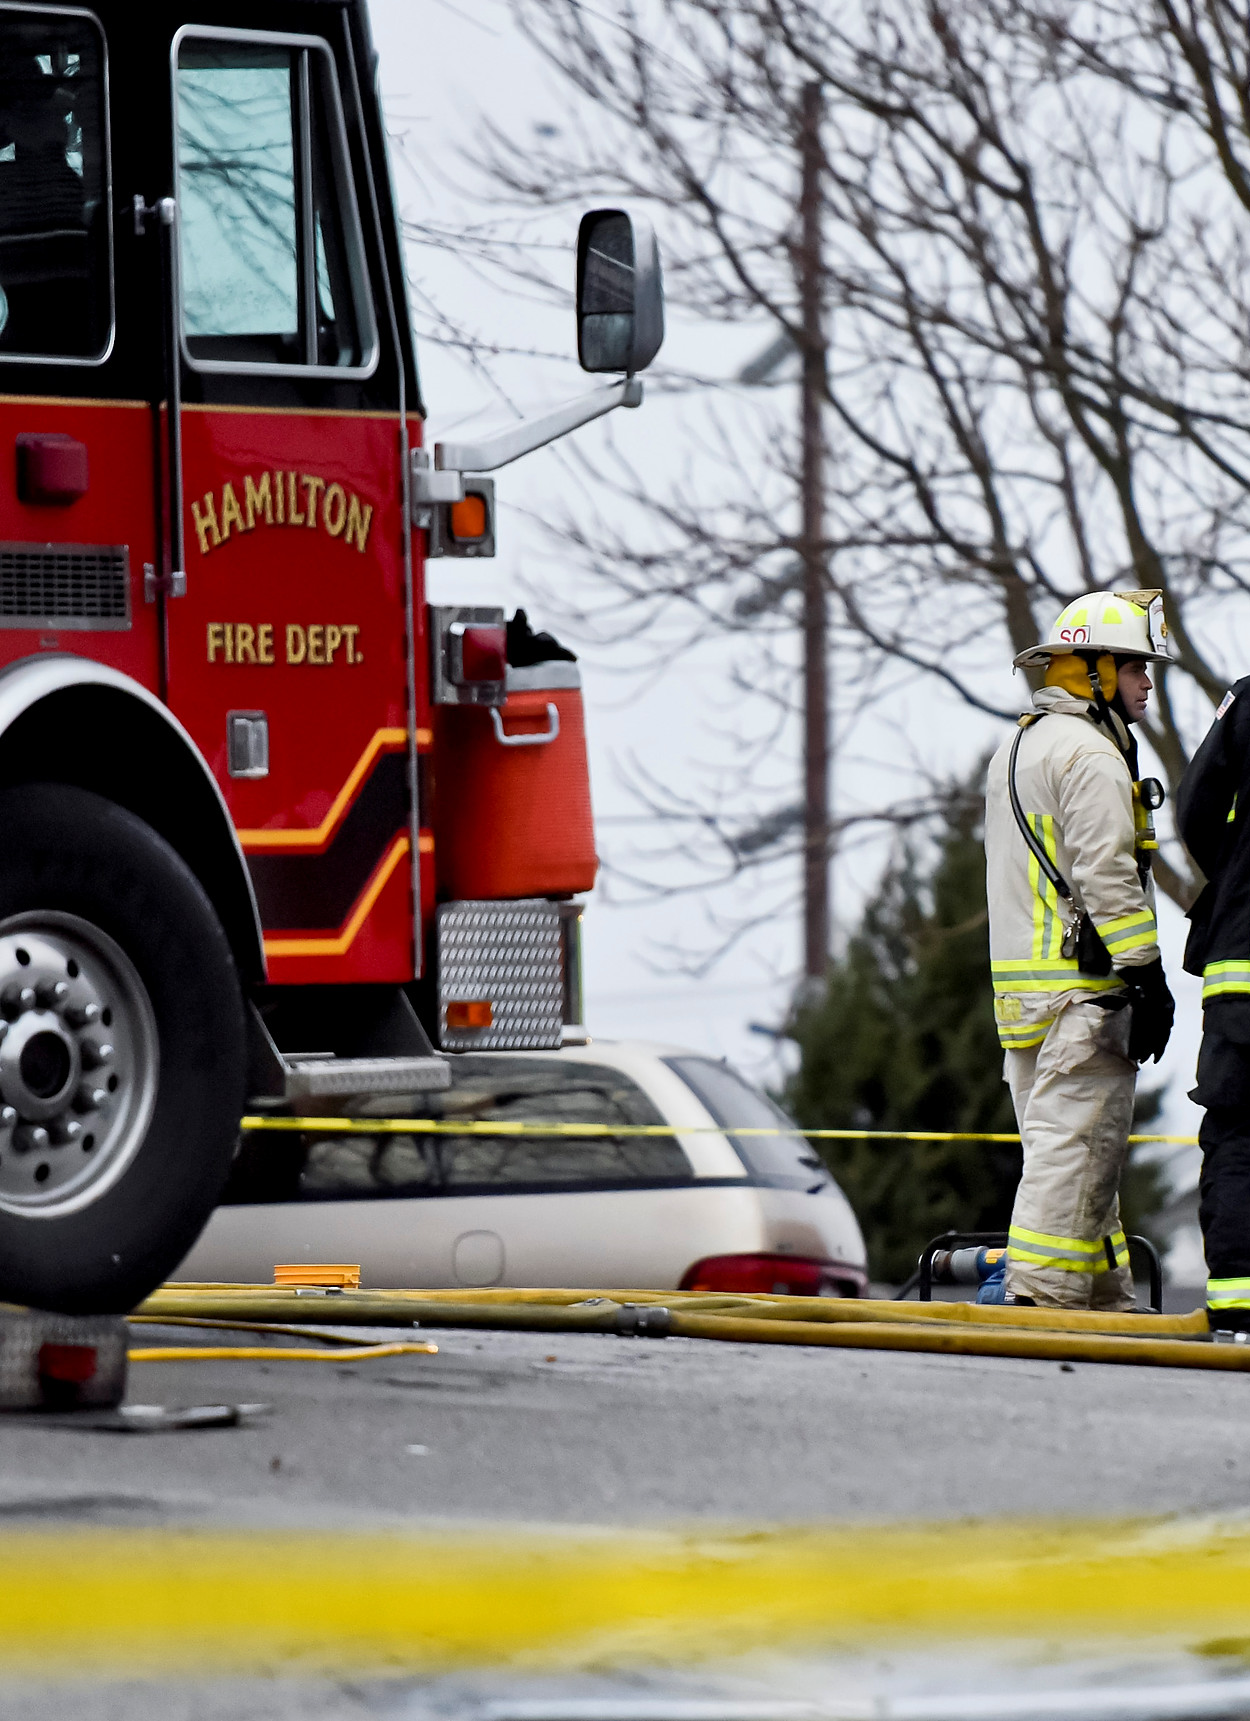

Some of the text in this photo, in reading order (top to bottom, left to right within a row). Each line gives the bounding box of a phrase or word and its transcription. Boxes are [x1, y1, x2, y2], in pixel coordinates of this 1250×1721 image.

[191, 470, 373, 554] HAMILTON
[207, 622, 364, 665] FIRE DEPT.
